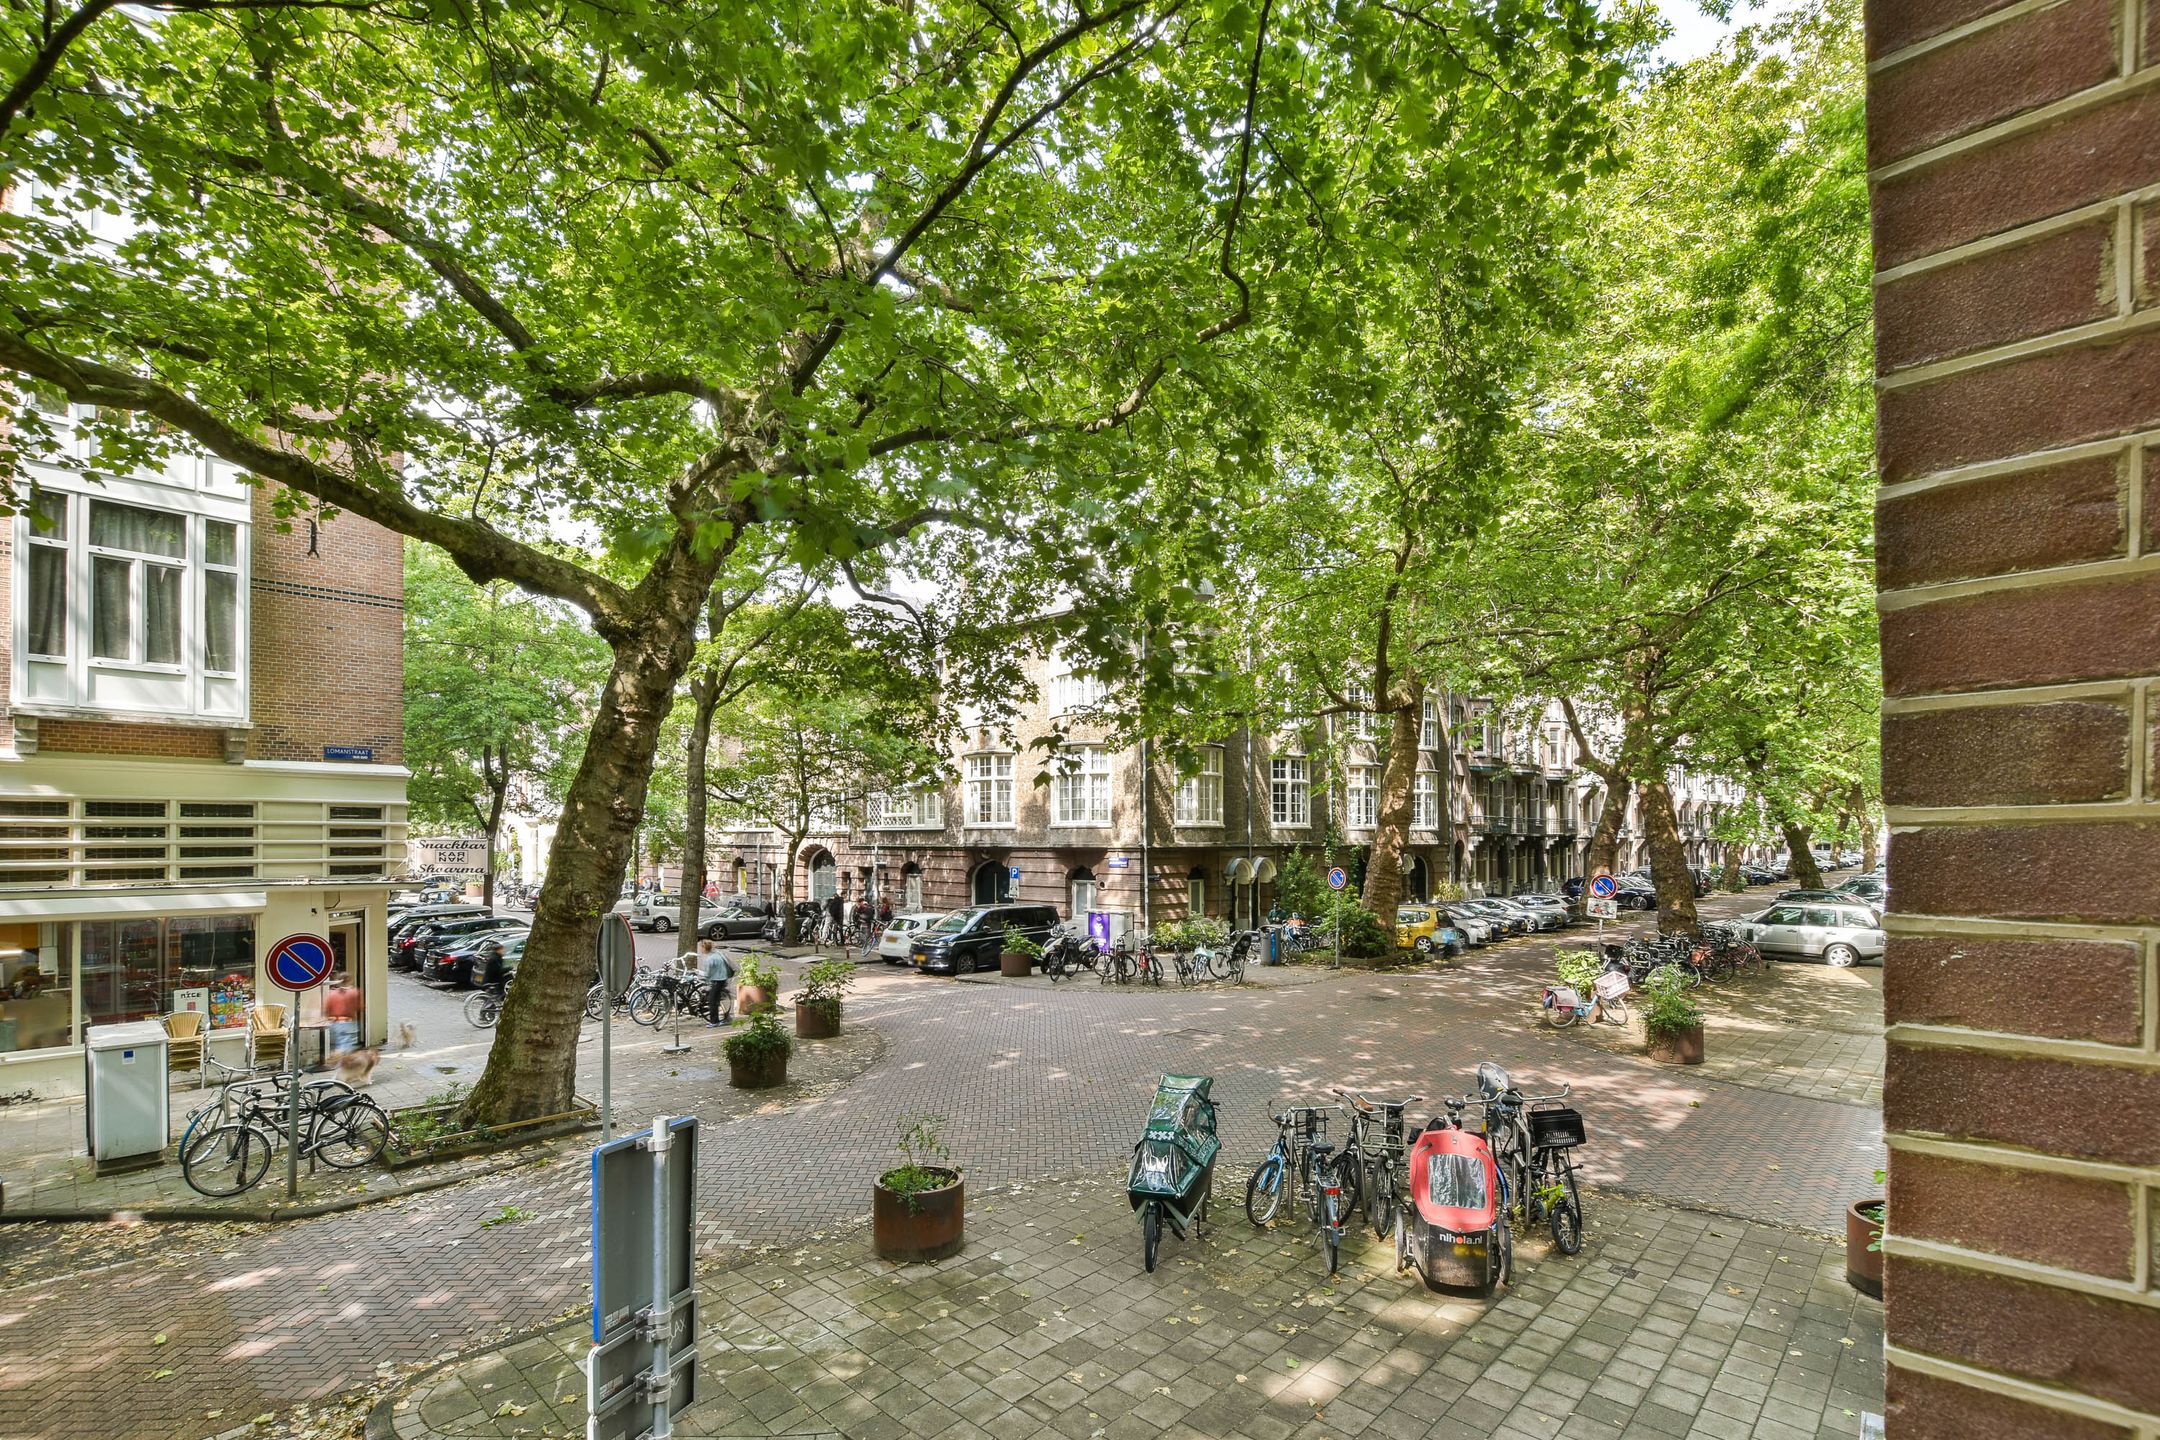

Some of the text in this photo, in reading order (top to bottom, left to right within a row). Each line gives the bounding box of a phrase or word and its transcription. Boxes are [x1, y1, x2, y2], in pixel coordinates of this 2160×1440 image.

[417, 840, 487, 850] Snackbar
[1011, 868, 1018, 878] P
[1439, 1233, 1483, 1245] nihola.nl
